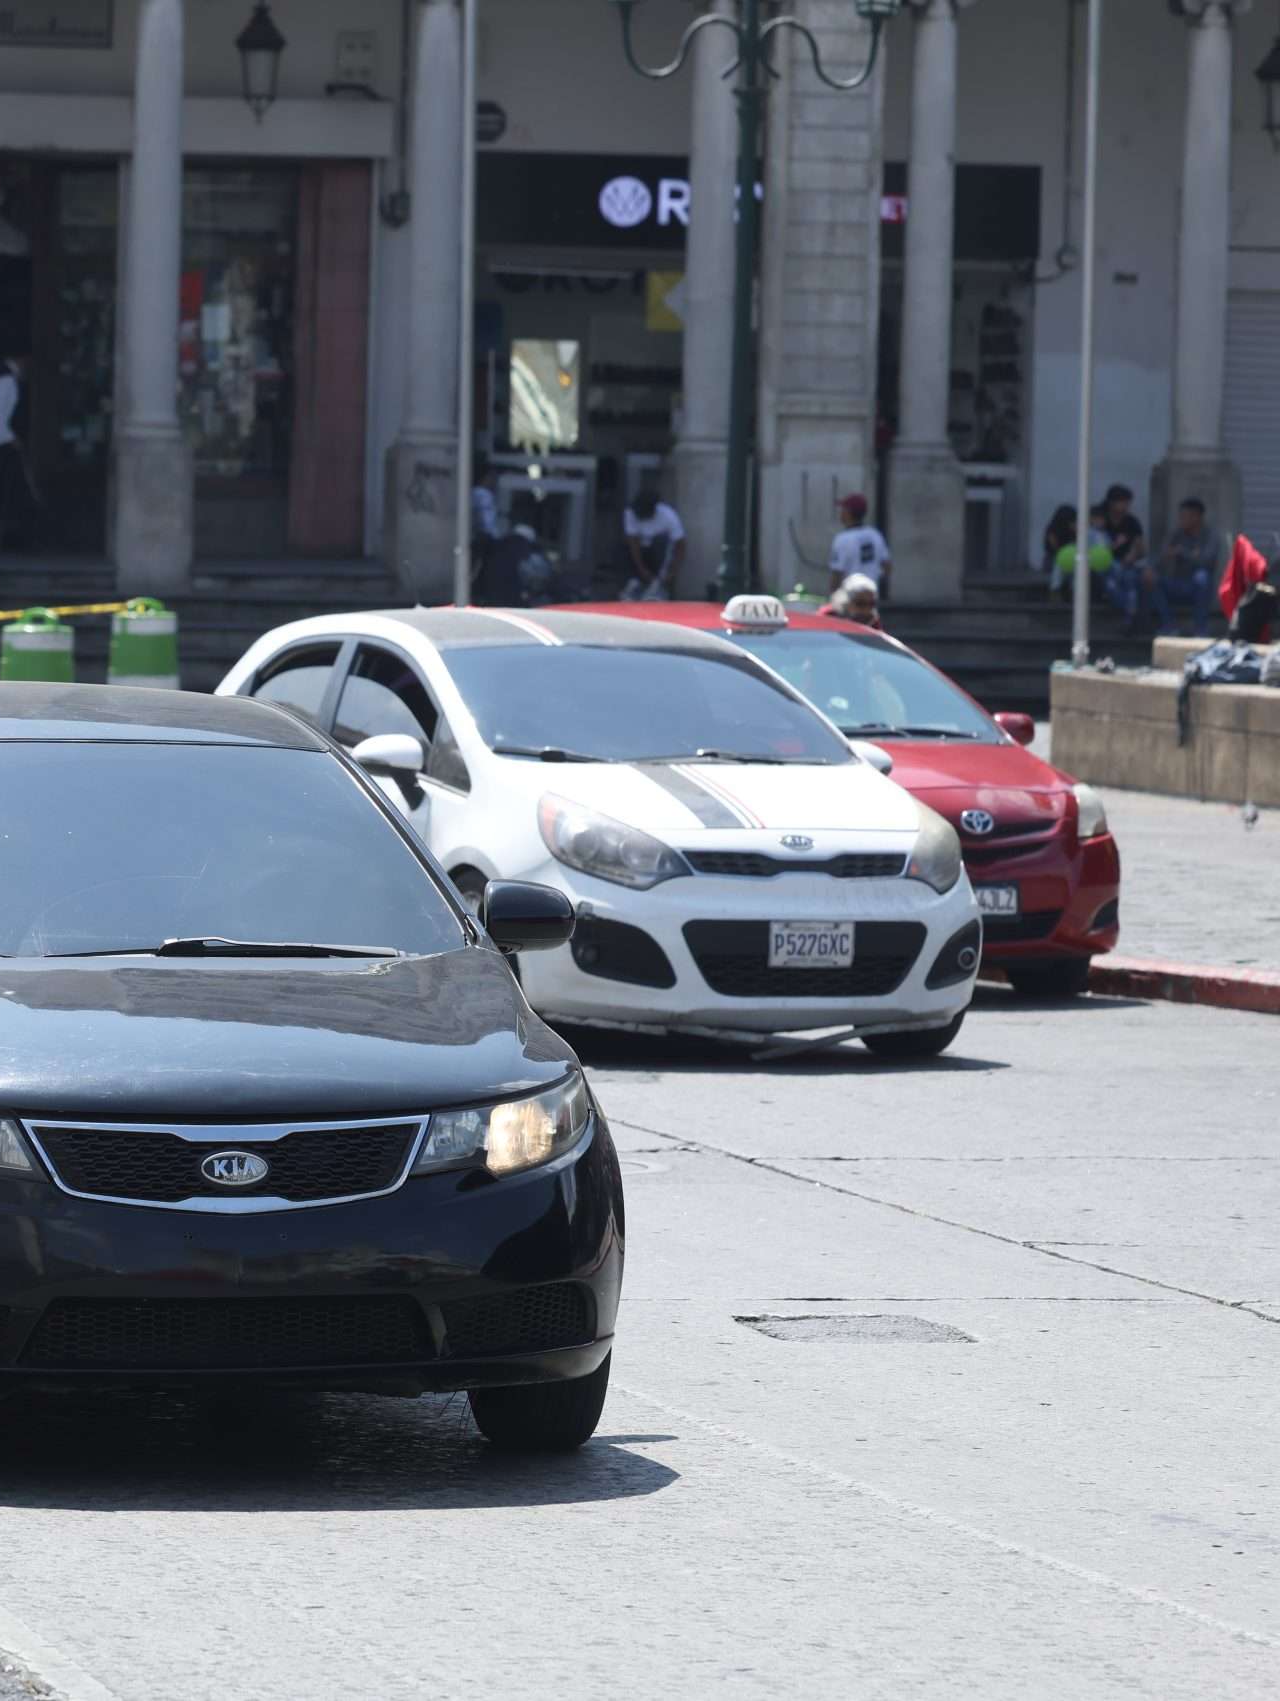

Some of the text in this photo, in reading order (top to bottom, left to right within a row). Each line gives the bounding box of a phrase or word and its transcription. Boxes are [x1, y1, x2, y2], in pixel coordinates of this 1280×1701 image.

[739, 603, 779, 617] TAXI
[774, 933, 850, 956] P527GXC
[212, 1156, 258, 1178] KIA
